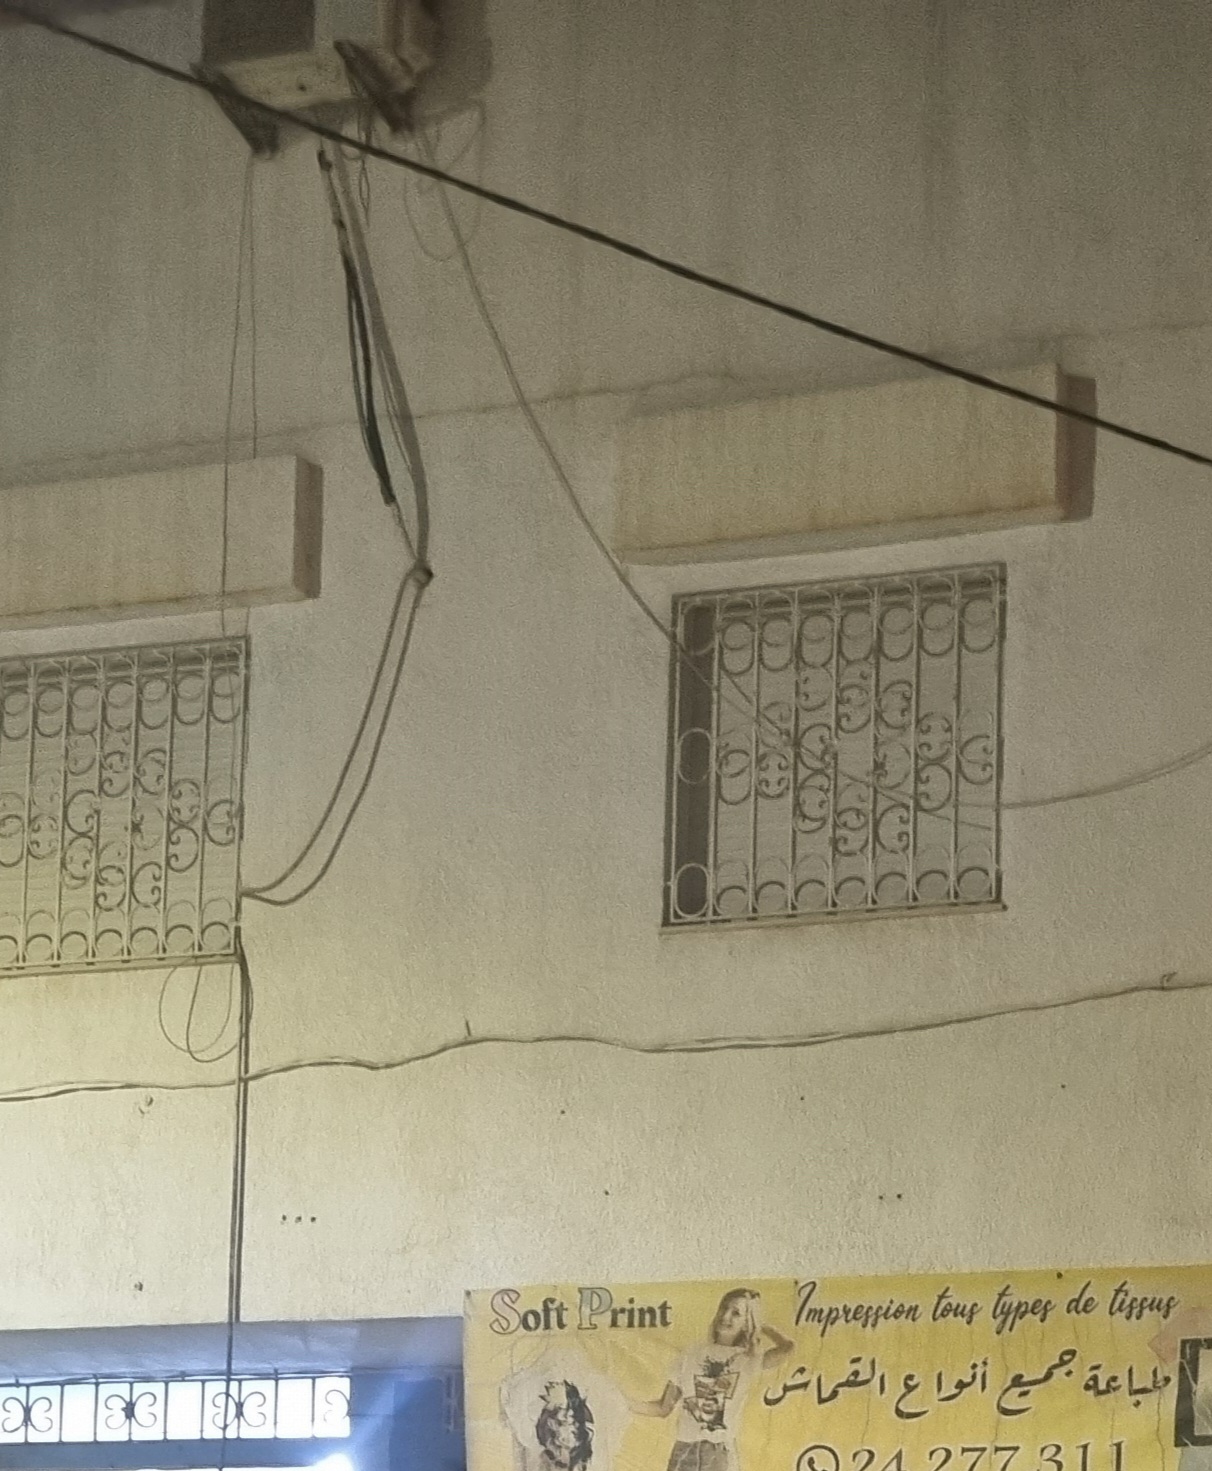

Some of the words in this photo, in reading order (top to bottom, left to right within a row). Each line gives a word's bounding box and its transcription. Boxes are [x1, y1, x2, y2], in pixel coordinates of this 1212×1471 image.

[490, 1288, 568, 1334] Soft
[577, 1287, 673, 1330] Print
[795, 1281, 922, 1337] Impression
[931, 1286, 983, 1324] tous
[992, 1284, 1056, 1335] types
[1066, 1281, 1099, 1315] de
[1108, 1280, 1179, 1322] tissus
[763, 1356, 886, 1406] القماش
[894, 1357, 989, 1419] أنواع
[996, 1348, 1078, 1416] جميع
[1082, 1363, 1173, 1407] طباعة
